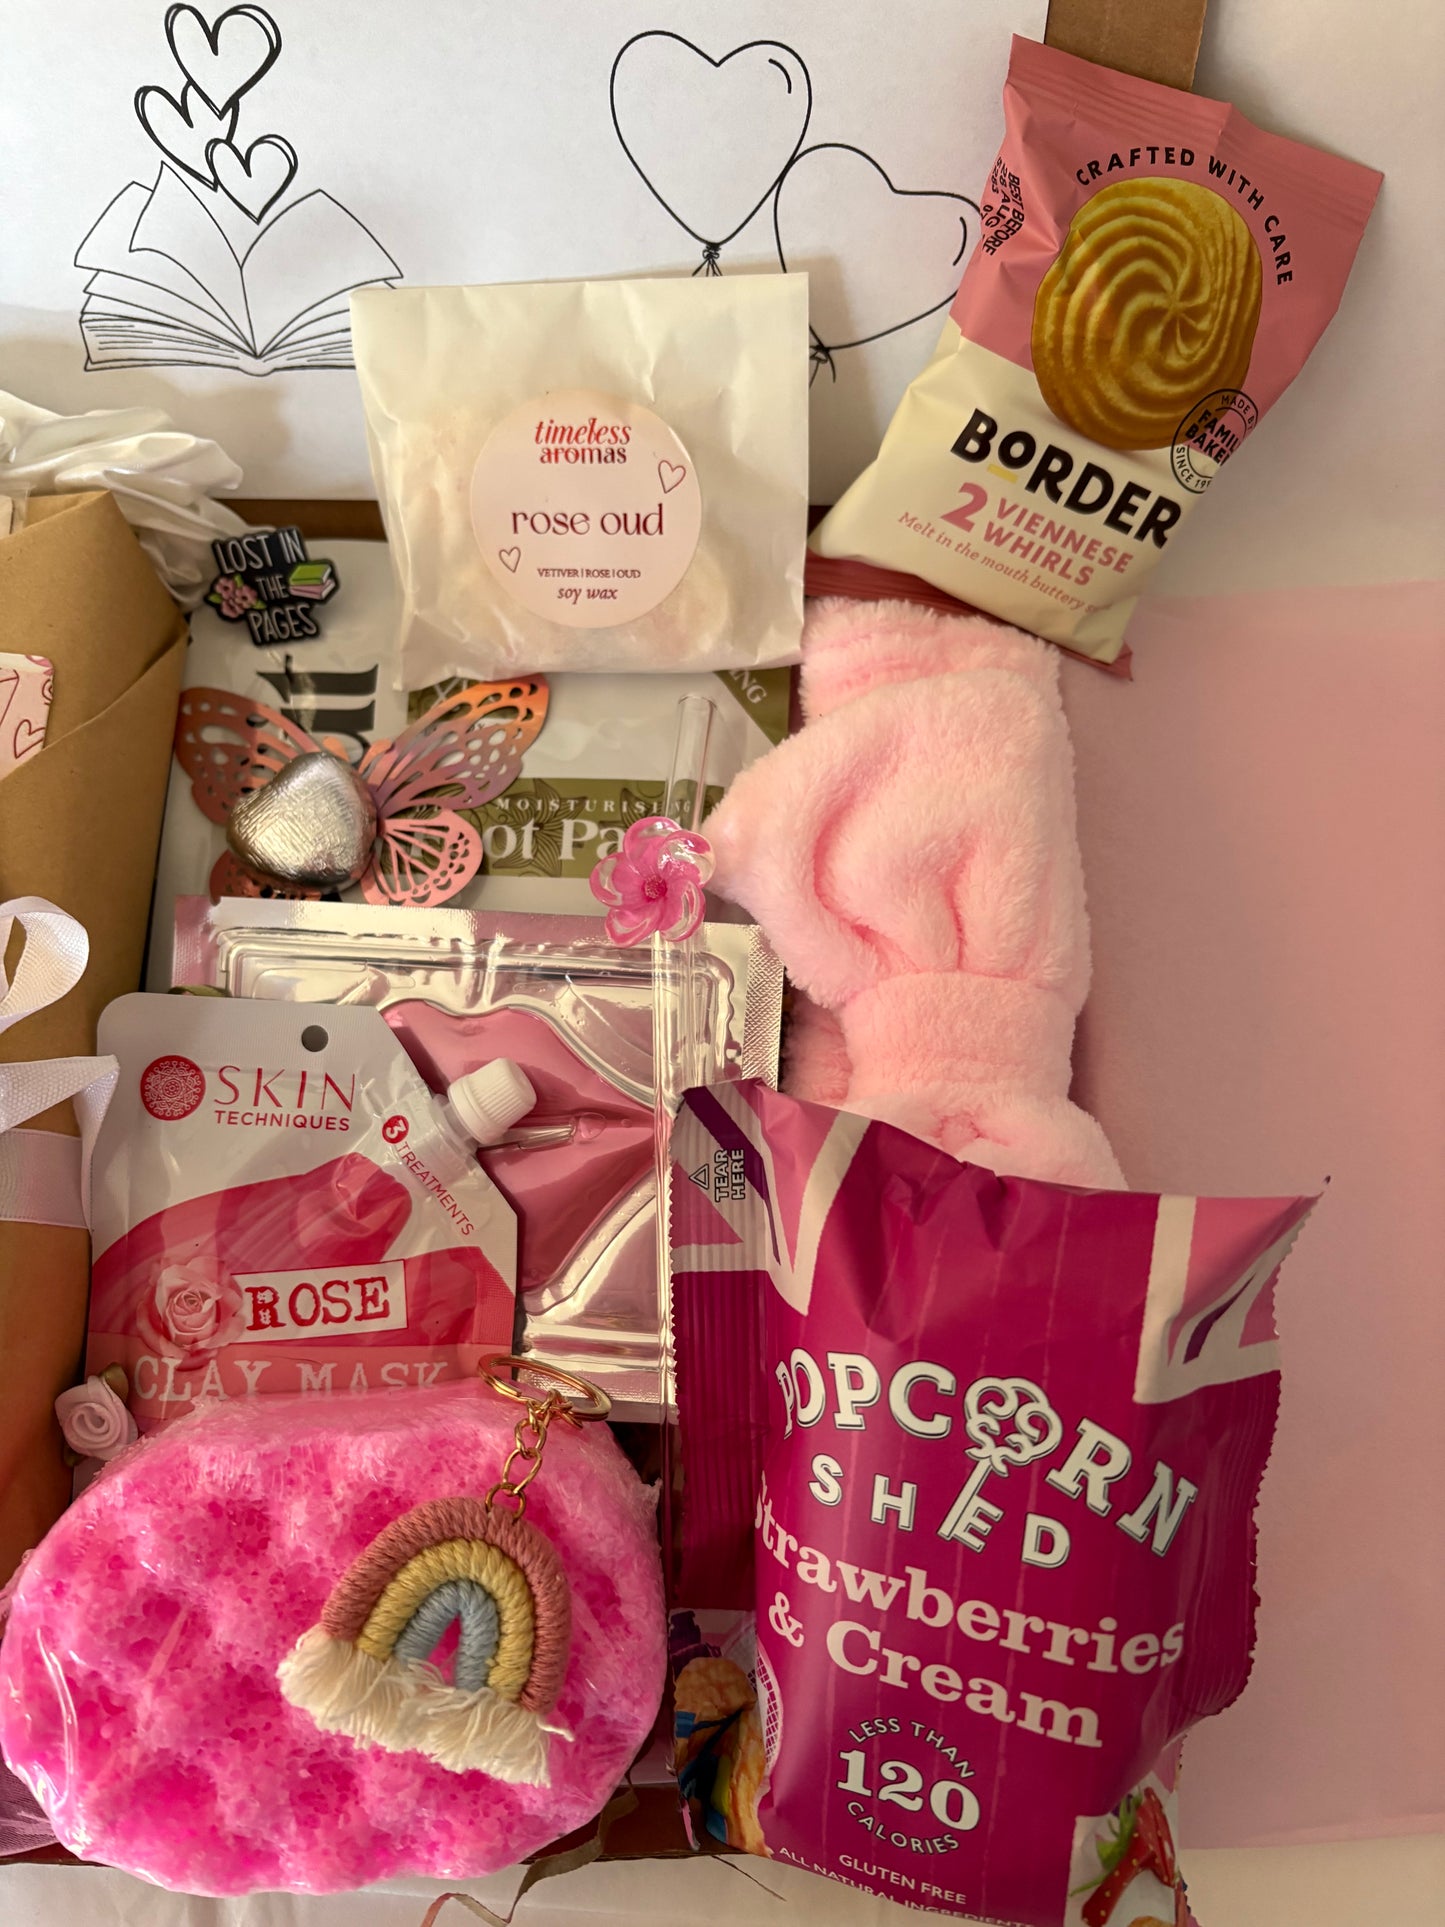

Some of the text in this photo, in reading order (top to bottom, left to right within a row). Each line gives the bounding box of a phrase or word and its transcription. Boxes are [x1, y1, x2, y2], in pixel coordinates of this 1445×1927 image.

[982, 172, 1025, 256] BEST BEFORE
[985, 189, 1011, 228] AUG
[1076, 146, 1293, 286] CRAFTED WITH CARE
[1221, 395, 1250, 414] MADE
[534, 417, 632, 445] timeless
[1185, 423, 1230, 467] BAKE
[1198, 409, 1240, 453] FAMIL
[540, 447, 627, 465] aromas
[950, 408, 1182, 549] BORDER
[1176, 446, 1212, 490] SINCE 19
[511, 503, 664, 536] rose oud
[940, 482, 988, 533] 2
[214, 527, 306, 575] LOST IN
[983, 521, 1094, 586] WHIRLS
[997, 497, 1134, 574] VIENNESE
[898, 511, 1086, 612] Melt in the mouth buttery
[255, 574, 289, 600] THE
[557, 587, 618, 605] soy wax
[249, 603, 318, 643] PAGES
[558, 818, 626, 861] Pa
[214, 1064, 357, 1112] SKIN
[214, 1110, 351, 1132] TECHNIQUES
[385, 1118, 475, 1236] 3 TREATMENTS
[715, 1149, 729, 1202] TEAR
[731, 1149, 745, 1200] HERE
[245, 1276, 391, 1332] ROSE
[134, 1355, 448, 1401] CLAY MASK
[808, 1453, 1072, 1569] SHED
[768, 1591, 1103, 1748] & Cream
[849, 1718, 975, 1779] LESS THAN
[836, 1749, 981, 1832] 120
[847, 1801, 959, 1854] CALORIES
[779, 1847, 811, 1869] ALL
[838, 1854, 967, 1905] GLUTEN FREE
